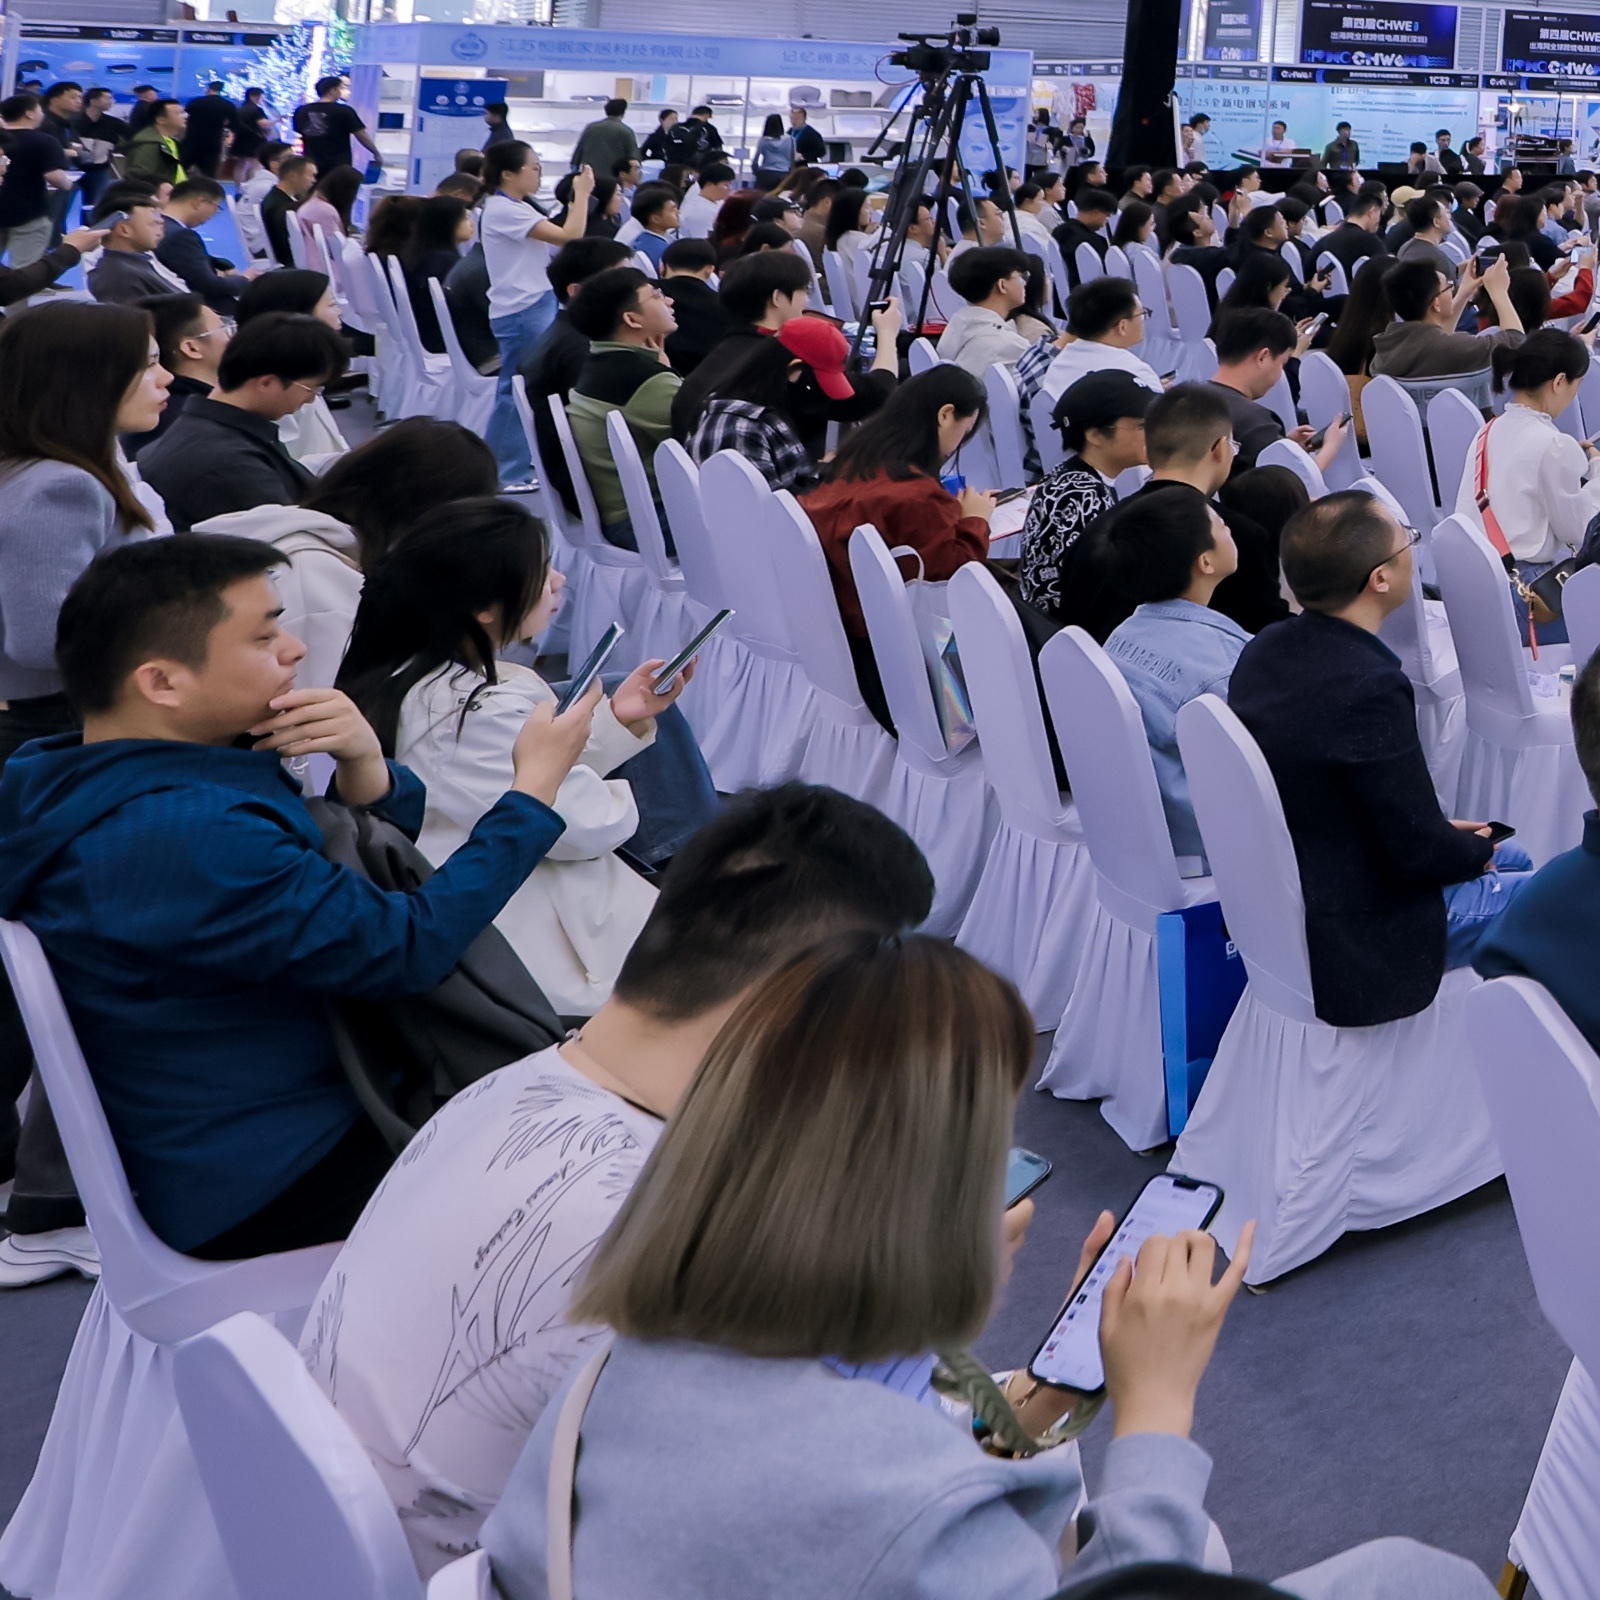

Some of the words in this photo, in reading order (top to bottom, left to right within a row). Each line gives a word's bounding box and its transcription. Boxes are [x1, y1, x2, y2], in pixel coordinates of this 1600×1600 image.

[1342, 16, 1413, 32] 第四届CHWE
[1429, 75, 1450, 85] 1C32
